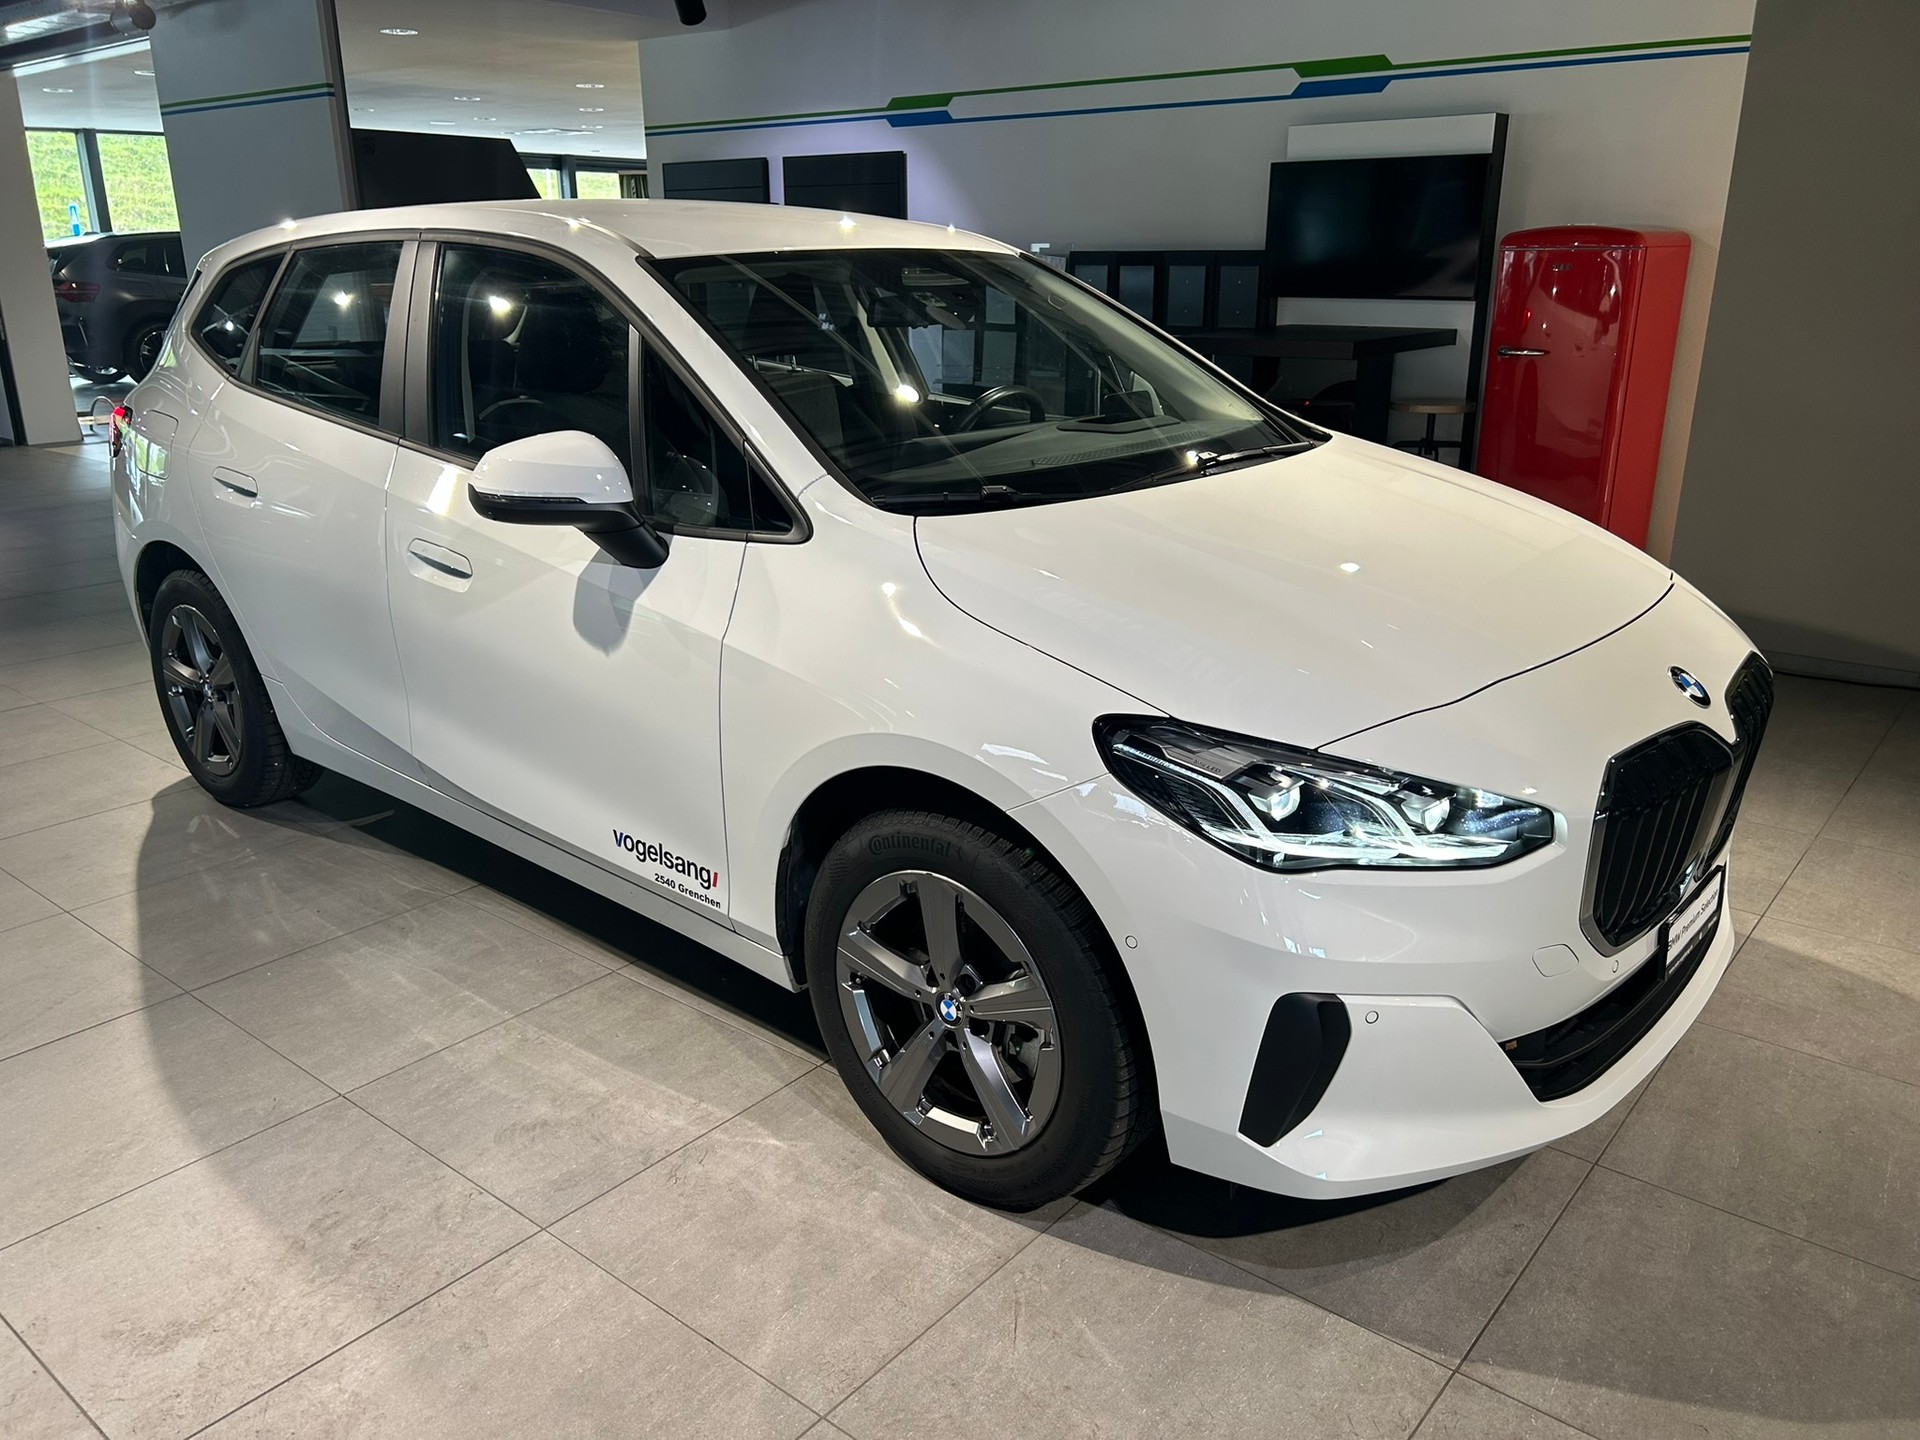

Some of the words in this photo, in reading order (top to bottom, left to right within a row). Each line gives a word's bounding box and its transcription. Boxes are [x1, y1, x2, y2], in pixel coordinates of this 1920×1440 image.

[613, 829, 712, 890] vogelsang
[869, 832, 950, 858] Continental
[655, 873, 676, 889] 2540
[678, 884, 721, 909] Grenchen
